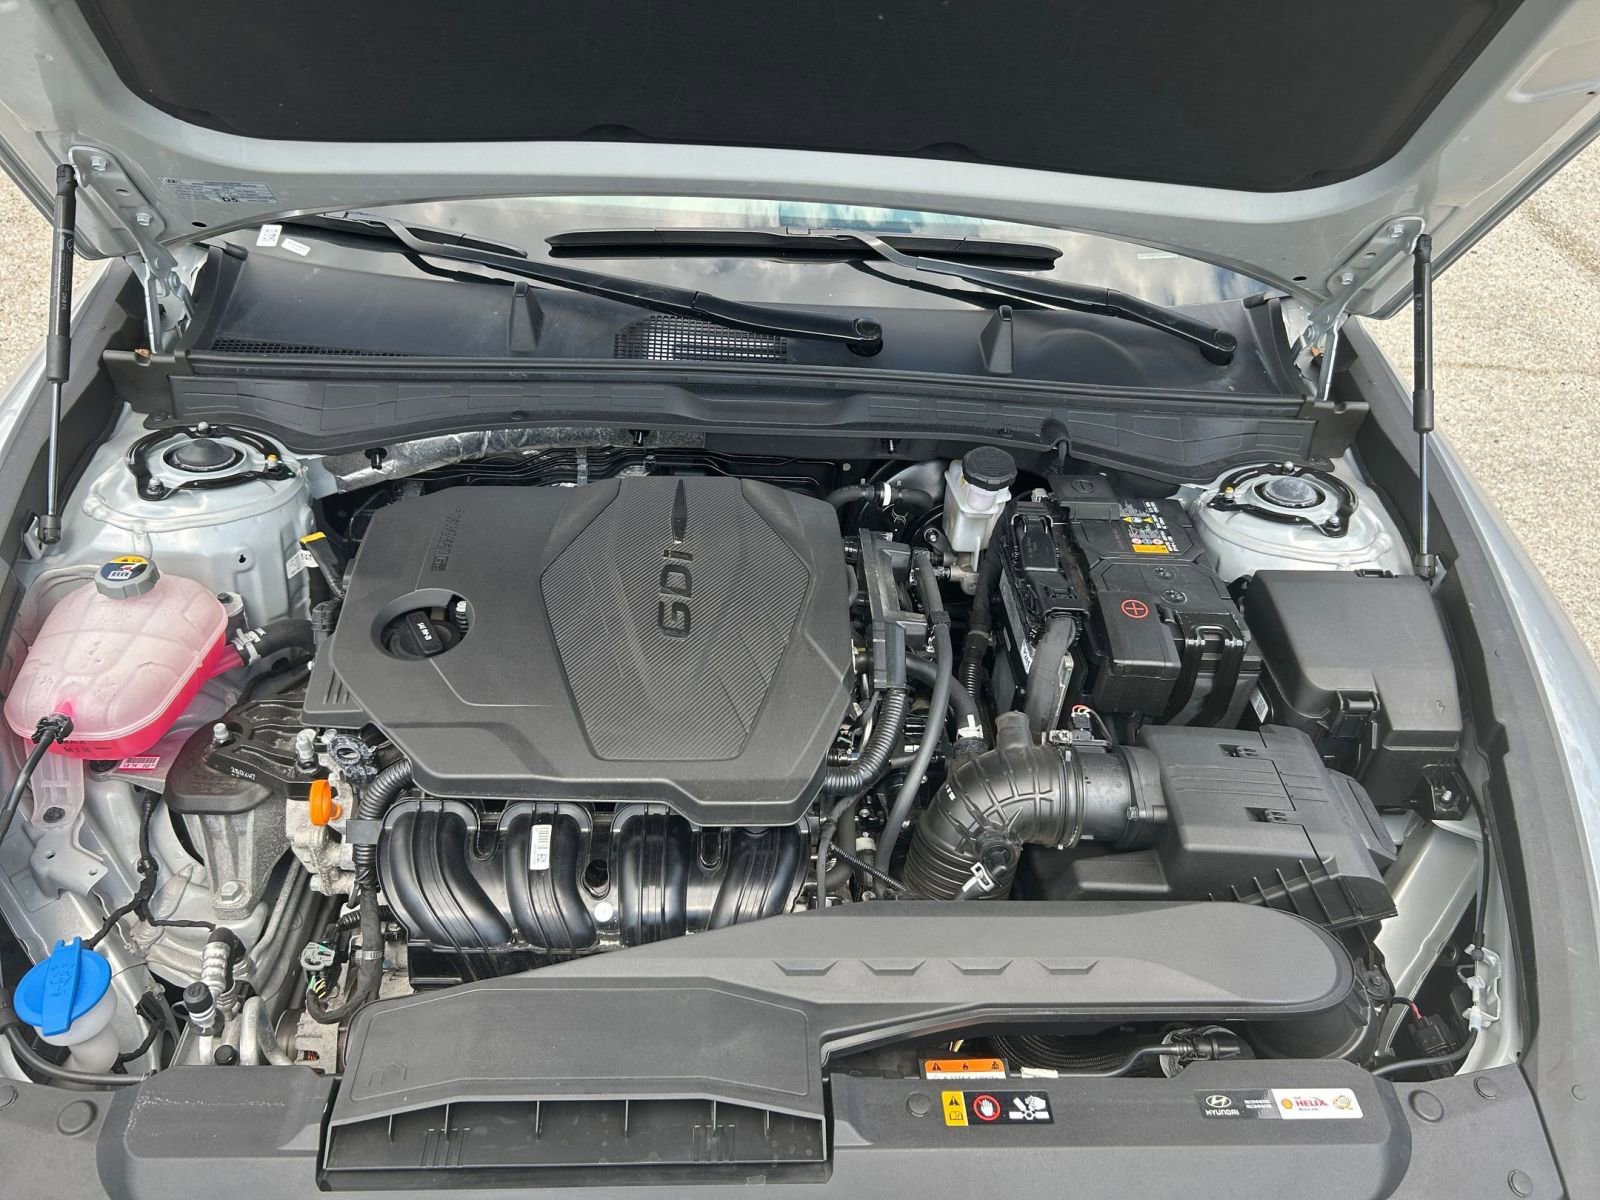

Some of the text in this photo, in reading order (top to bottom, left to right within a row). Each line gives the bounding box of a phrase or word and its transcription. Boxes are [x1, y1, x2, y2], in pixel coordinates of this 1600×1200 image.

[657, 549, 693, 641] GDi
[1295, 1099, 1328, 1108] HELIX
[1204, 1108, 1240, 1116] HYUNDAI
